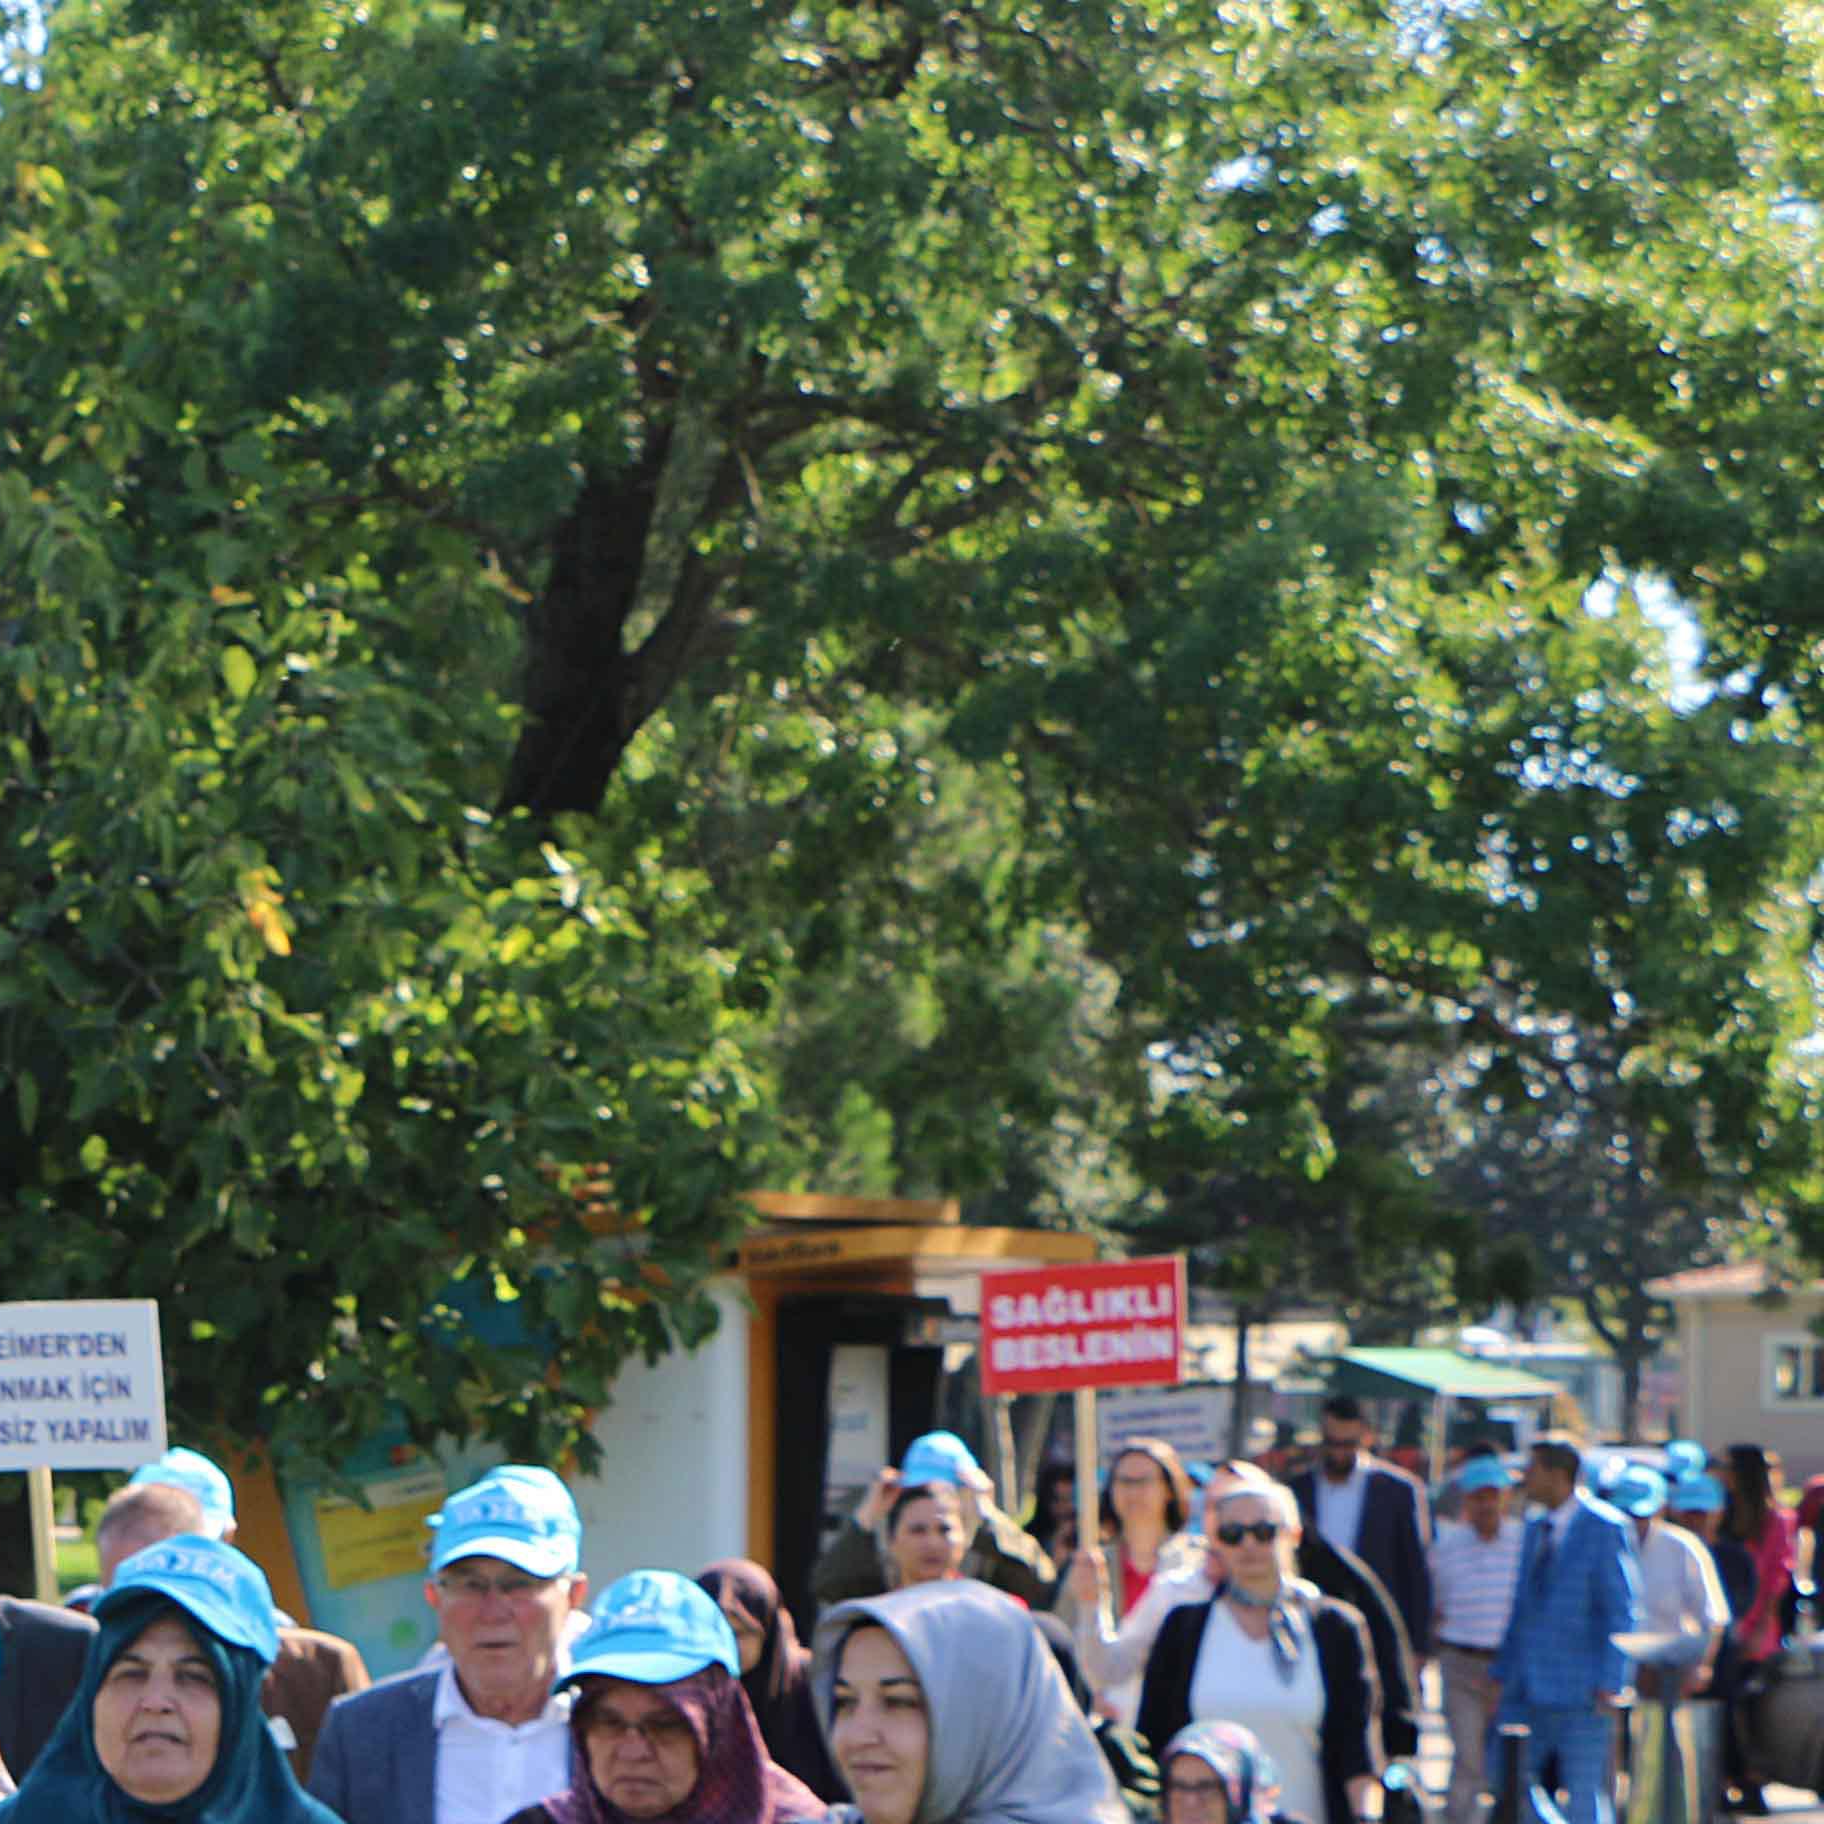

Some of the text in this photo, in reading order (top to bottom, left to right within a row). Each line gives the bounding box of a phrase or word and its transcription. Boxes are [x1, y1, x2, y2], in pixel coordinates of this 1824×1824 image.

[989, 1284, 1175, 1330] SAĞLIKLI
[81, 1370, 133, 1406] İÇİN
[45, 1417, 151, 1443] YAPALIM
